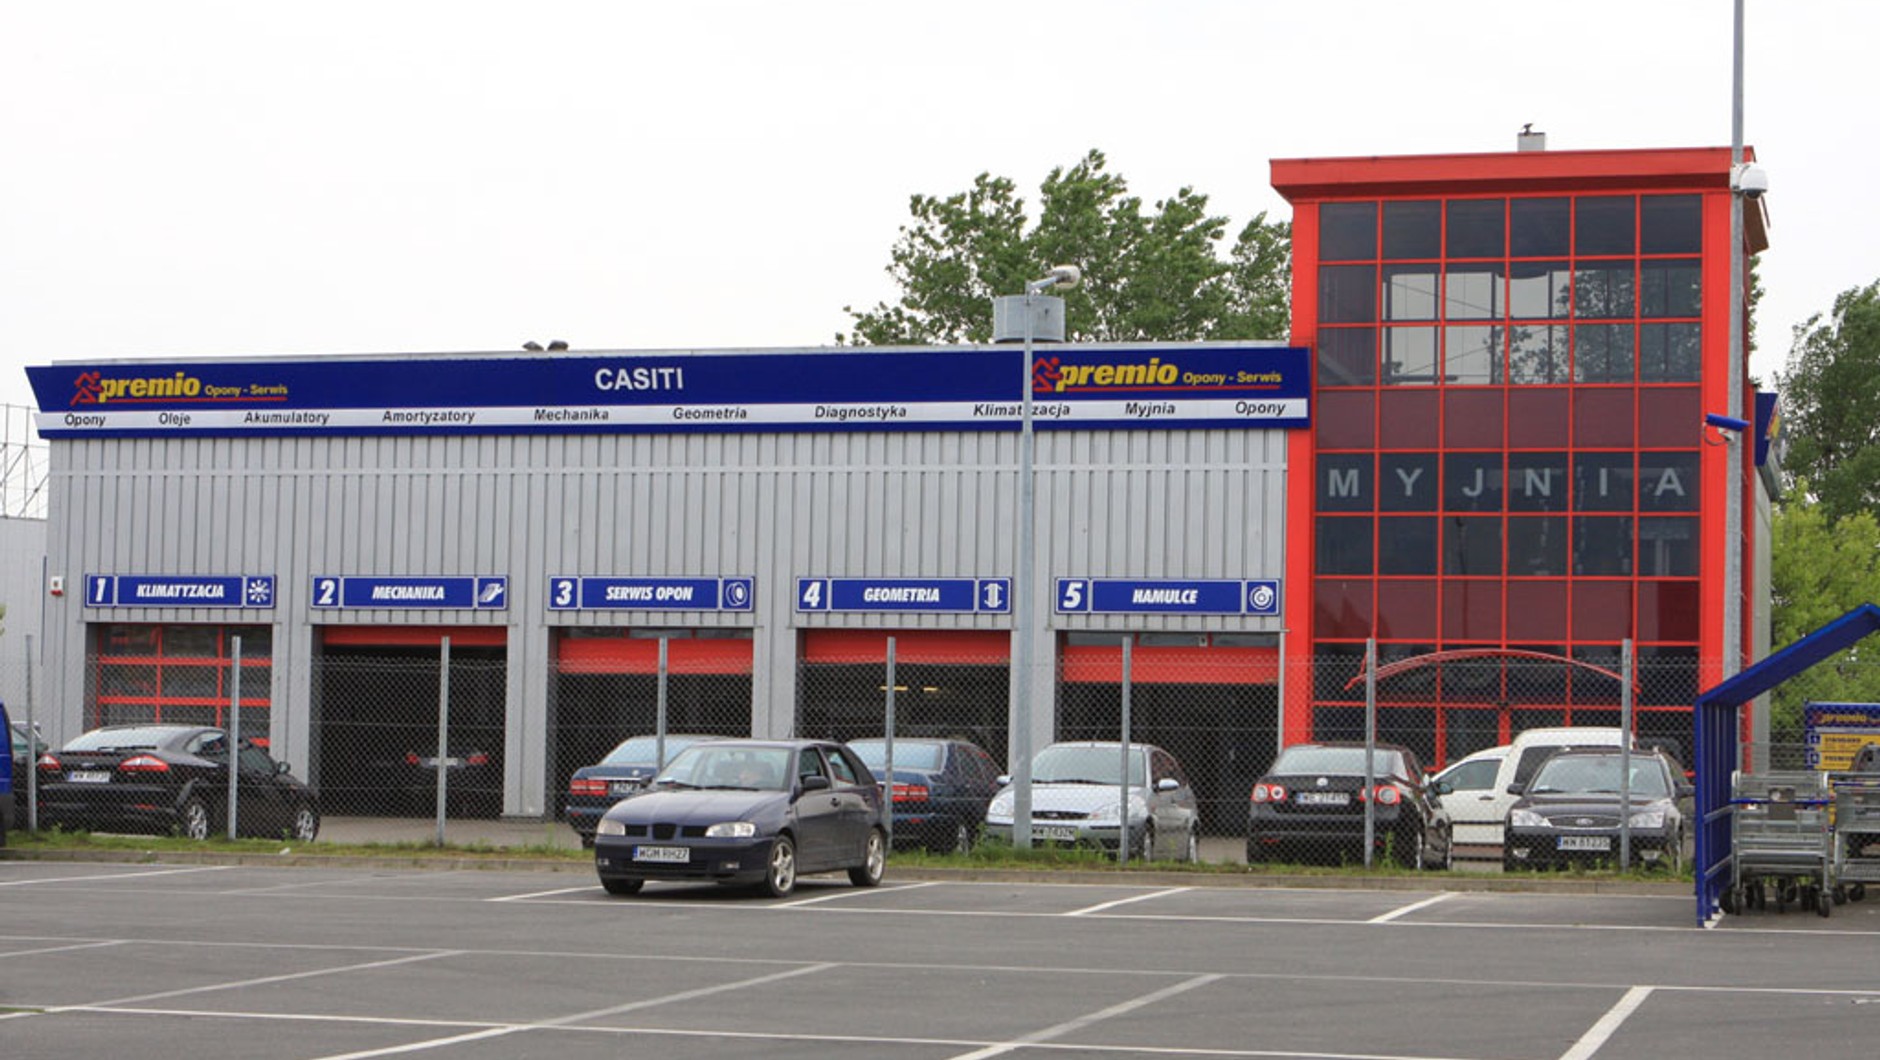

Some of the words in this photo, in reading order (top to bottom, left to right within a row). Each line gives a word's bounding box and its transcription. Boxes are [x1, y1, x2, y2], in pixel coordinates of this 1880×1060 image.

[595, 367, 684, 390] CASITI
[1056, 358, 1178, 391] premio
[1183, 372, 1226, 385] Opony
[1237, 371, 1282, 383] Serwis
[99, 372, 201, 403] premio
[204, 385, 242, 398] Opony
[250, 384, 288, 395] Serwis
[64, 413, 106, 427] Opony
[158, 412, 191, 425] Oleje
[244, 411, 330, 426] Akumulatory
[382, 410, 476, 424] Amortyzatory
[534, 408, 609, 421] Mechanika
[673, 406, 747, 420] Geometria
[815, 405, 907, 420] Diagnostyka
[973, 403, 1071, 418] Klimatzacja
[1125, 402, 1176, 417] Myjnia
[1235, 401, 1286, 416] Opony
[95, 579, 106, 602] 1
[136, 583, 224, 599] KLIMATYZACJA
[317, 580, 335, 605] 2
[372, 586, 445, 600] MECHANIKA
[556, 581, 572, 605] 3
[606, 586, 653, 601] SERWIS
[655, 586, 693, 601] OPON
[803, 582, 821, 607] 4
[864, 588, 940, 602] GEOMETRIA
[1062, 582, 1083, 608] 5
[1132, 589, 1198, 604] HAMULCE
